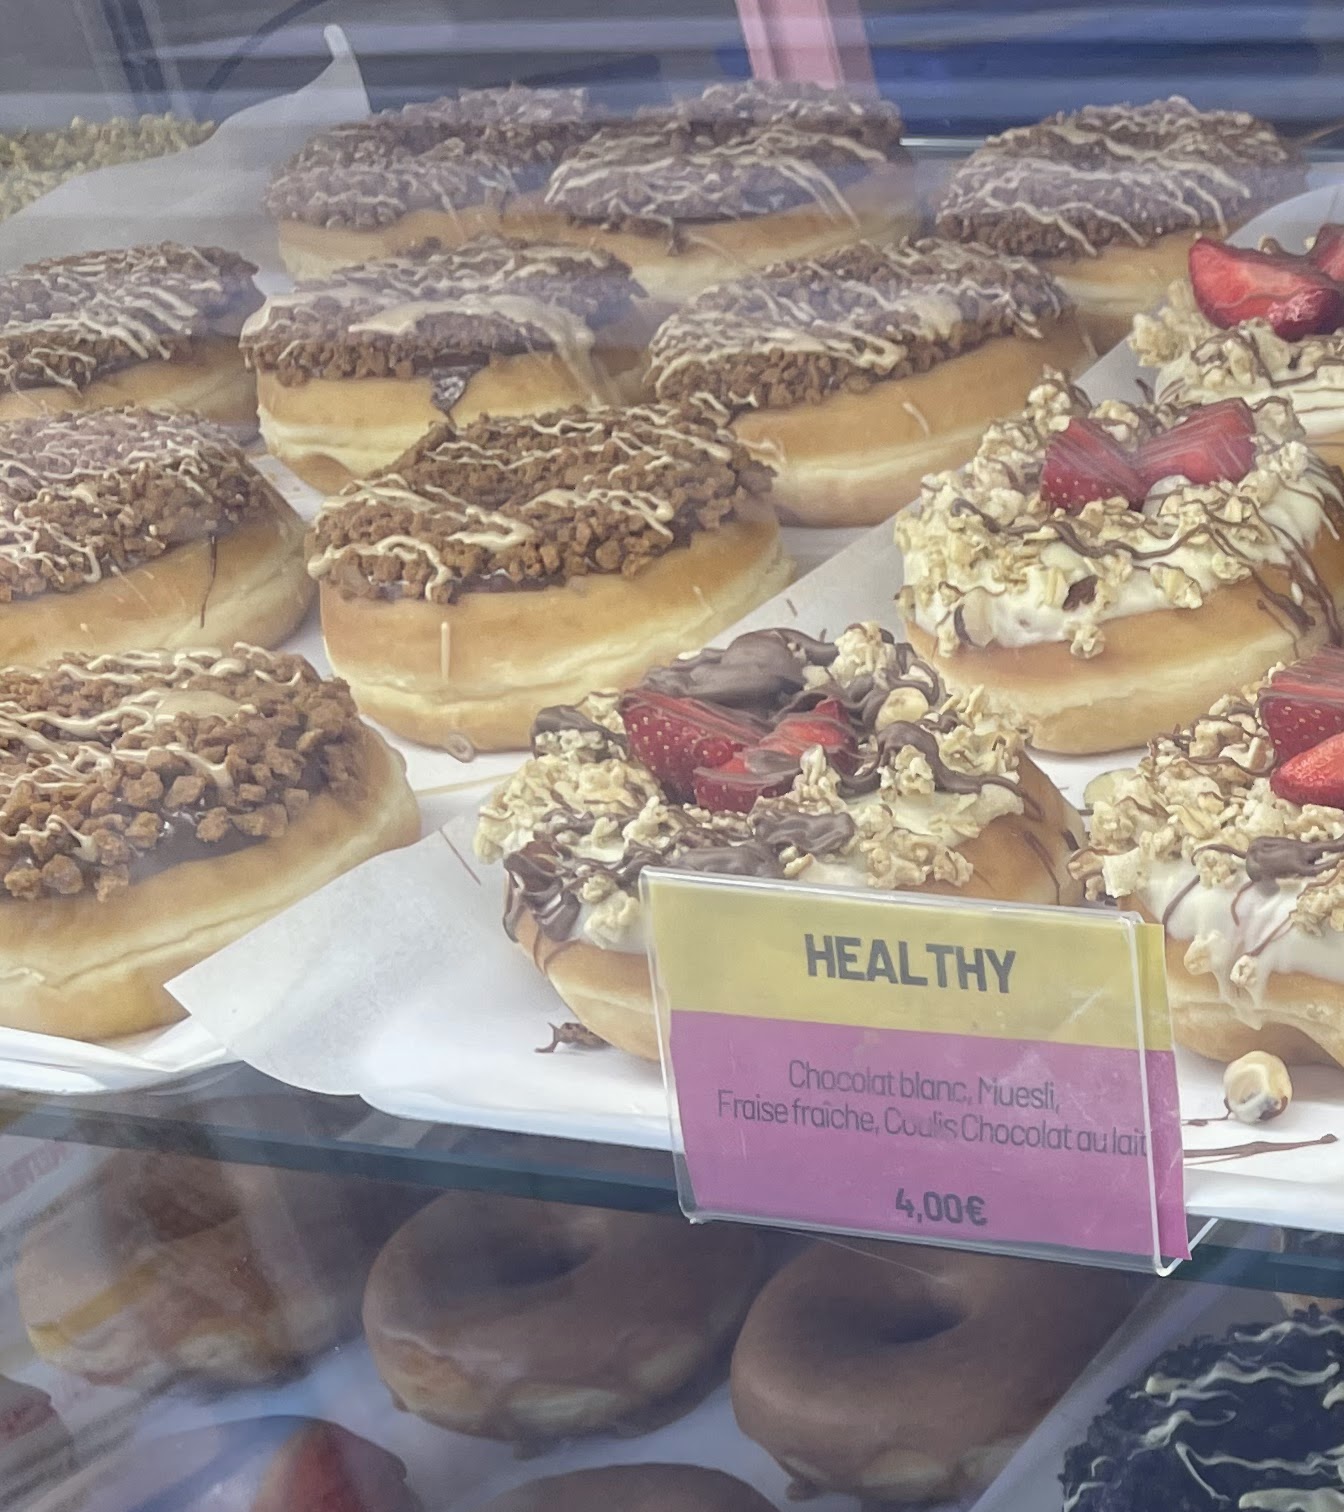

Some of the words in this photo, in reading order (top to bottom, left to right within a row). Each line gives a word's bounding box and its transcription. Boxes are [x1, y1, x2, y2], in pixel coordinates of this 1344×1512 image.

[804, 932, 1017, 994] HEALTHY
[788, 1059, 896, 1098] Chocolat
[900, 1071, 973, 1106] blanc,
[977, 1076, 1060, 1115] Muesli,
[717, 1089, 789, 1125] Fraise
[792, 1098, 880, 1136] fraîche,
[961, 1113, 1072, 1151] Chocolat
[1077, 1130, 1109, 1154] au
[1112, 1126, 1149, 1157] lait
[895, 1187, 988, 1226] 4,00€
